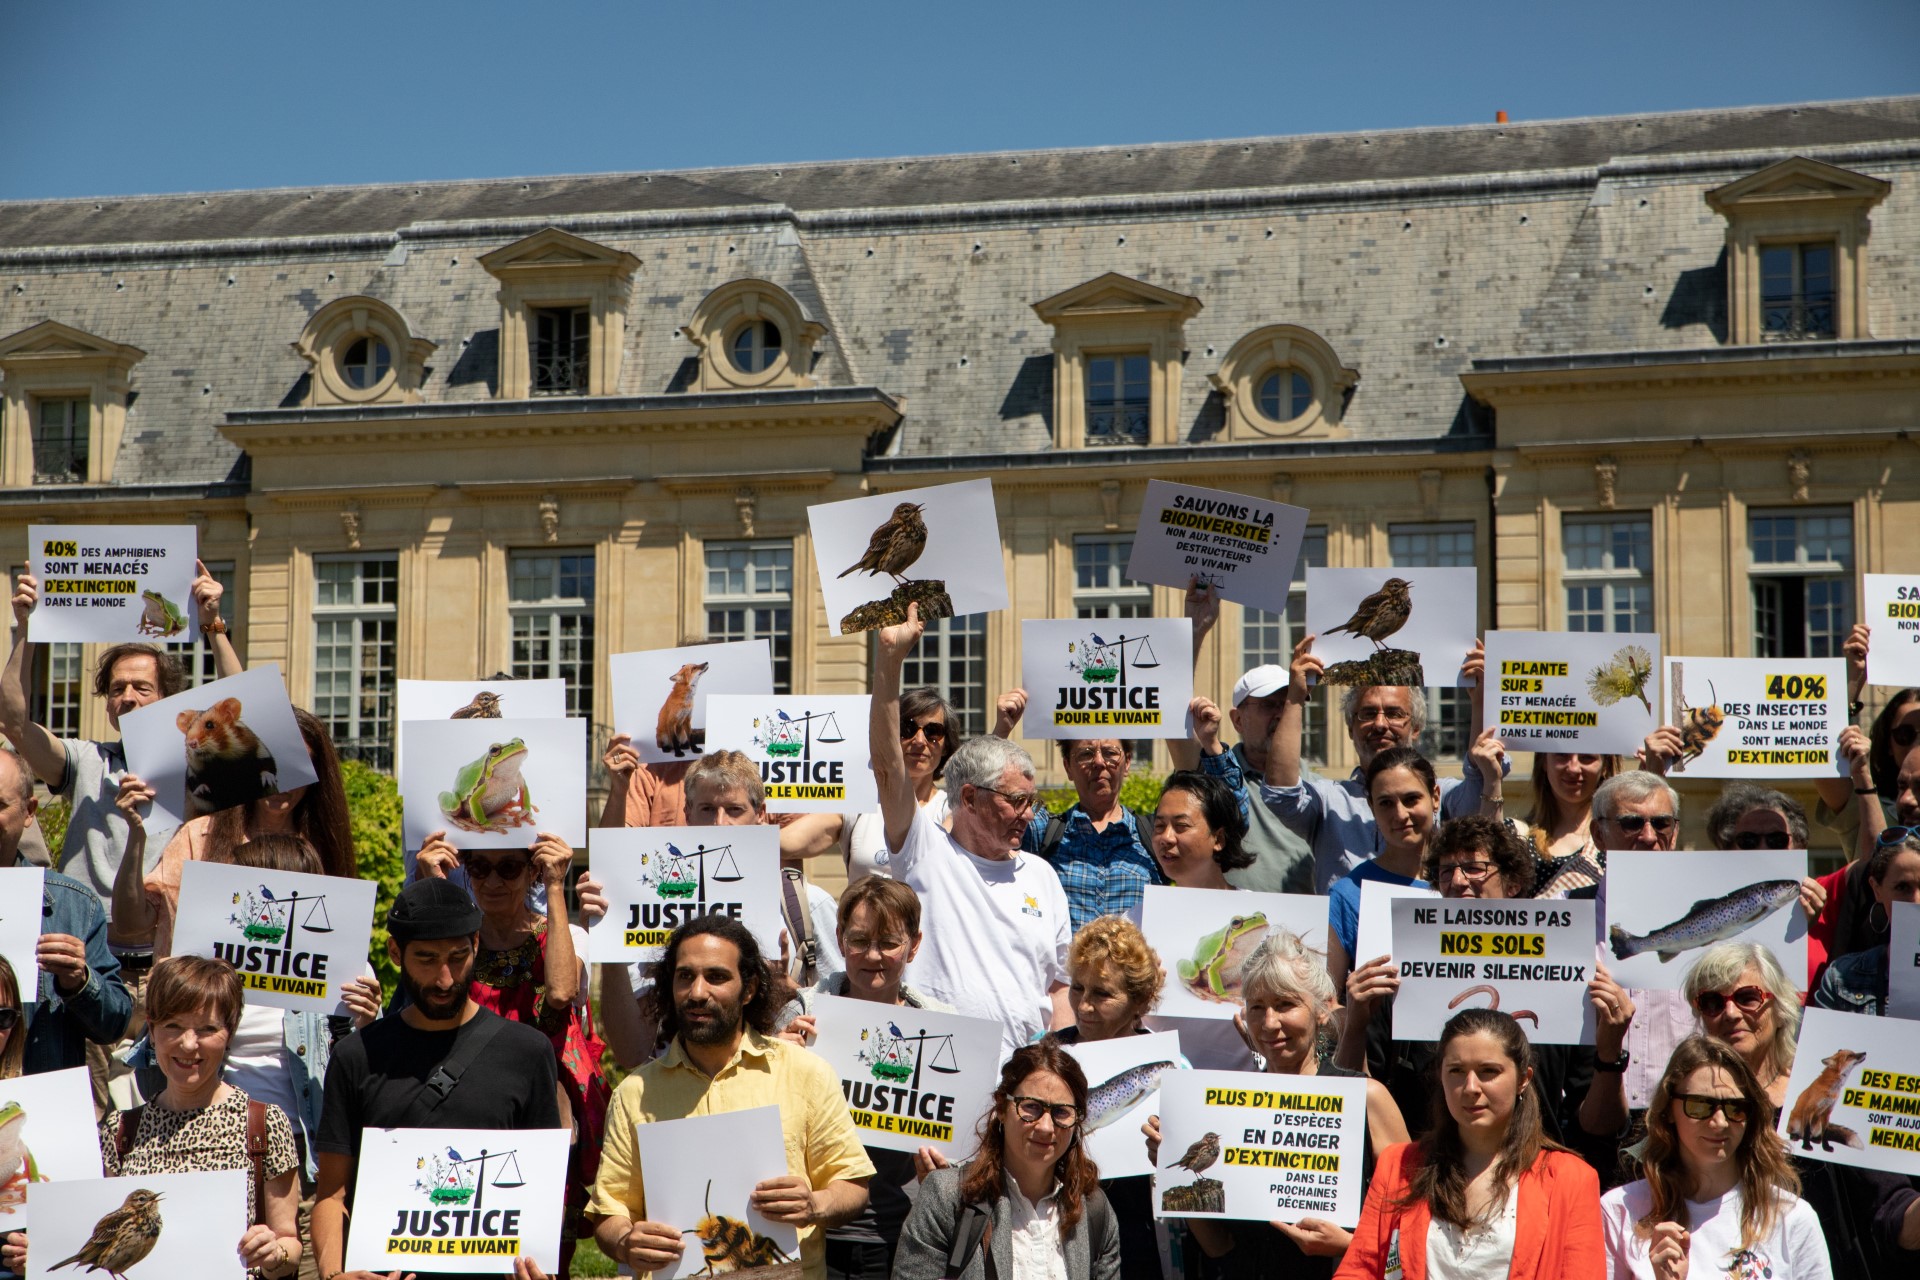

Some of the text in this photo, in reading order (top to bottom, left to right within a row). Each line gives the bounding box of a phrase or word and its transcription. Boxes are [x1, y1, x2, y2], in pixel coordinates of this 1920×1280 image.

[1172, 495, 1274, 527] SAUVONS LA
[1160, 509, 1271, 543] BIODIVERSITÉ
[1165, 526, 1268, 555] NON AUX PESTICIDES
[44, 541, 166, 558] 40% DES AMPHIBIENS
[1176, 541, 1252, 564] DESTRUCTEURS
[45, 559, 149, 575] SONT MENACÉS
[1184, 555, 1238, 573] DU VIVANT
[44, 579, 136, 593] D'EXTINCTION
[45, 597, 126, 607] DANS LE MONDE
[1898, 621, 1919, 630] NON
[1502, 662, 1568, 676] 1 PLANTE
[1501, 679, 1542, 692] SUR 5
[1768, 675, 1825, 699] 40%
[1056, 686, 1159, 709] JUSTICE
[1501, 694, 1577, 707] EST MENACÉE
[1500, 710, 1597, 725] D'EXTINCTION
[1723, 703, 1827, 716] DES INSECTES
[1055, 712, 1160, 724] POUR LE VIVANT
[1738, 720, 1828, 730] DANS LE MONDE
[1500, 728, 1579, 739] DANS LE MONDE
[1742, 733, 1829, 746] SONT MENACÉS
[1728, 750, 1829, 764] D'EXTINCTION
[756, 761, 843, 783] USTICE
[777, 786, 791, 797] LE
[796, 786, 843, 798] VIVANT
[1414, 908, 1571, 927] NE LAISSONS PAS
[625, 932, 666, 945] POUR
[1441, 934, 1544, 956] NOS SOLS
[1400, 961, 1585, 982] DEVENIR SILENCIEUX
[251, 975, 267, 989] LE
[272, 977, 325, 996] VIVANT
[1861, 1071, 1891, 1089] DES
[1206, 1089, 1247, 1106] PLUS
[1279, 1094, 1343, 1113] MILLION
[1843, 1089, 1865, 1106] DE
[877, 1115, 894, 1131] LE
[899, 1119, 951, 1140] VIVANT
[1274, 1113, 1342, 1129] D'ESPÈCES
[1867, 1113, 1893, 1126] SONT
[1243, 1128, 1340, 1149] EN DANGER
[1224, 1148, 1339, 1171] D'EXTINCTION
[1286, 1172, 1338, 1185] DANS LES
[1270, 1184, 1337, 1199] PROCHAINES
[1277, 1196, 1337, 1212] DÉCENNIES
[391, 1210, 521, 1237] JUSTICE
[388, 1239, 518, 1254] POUR LE VIVANT
